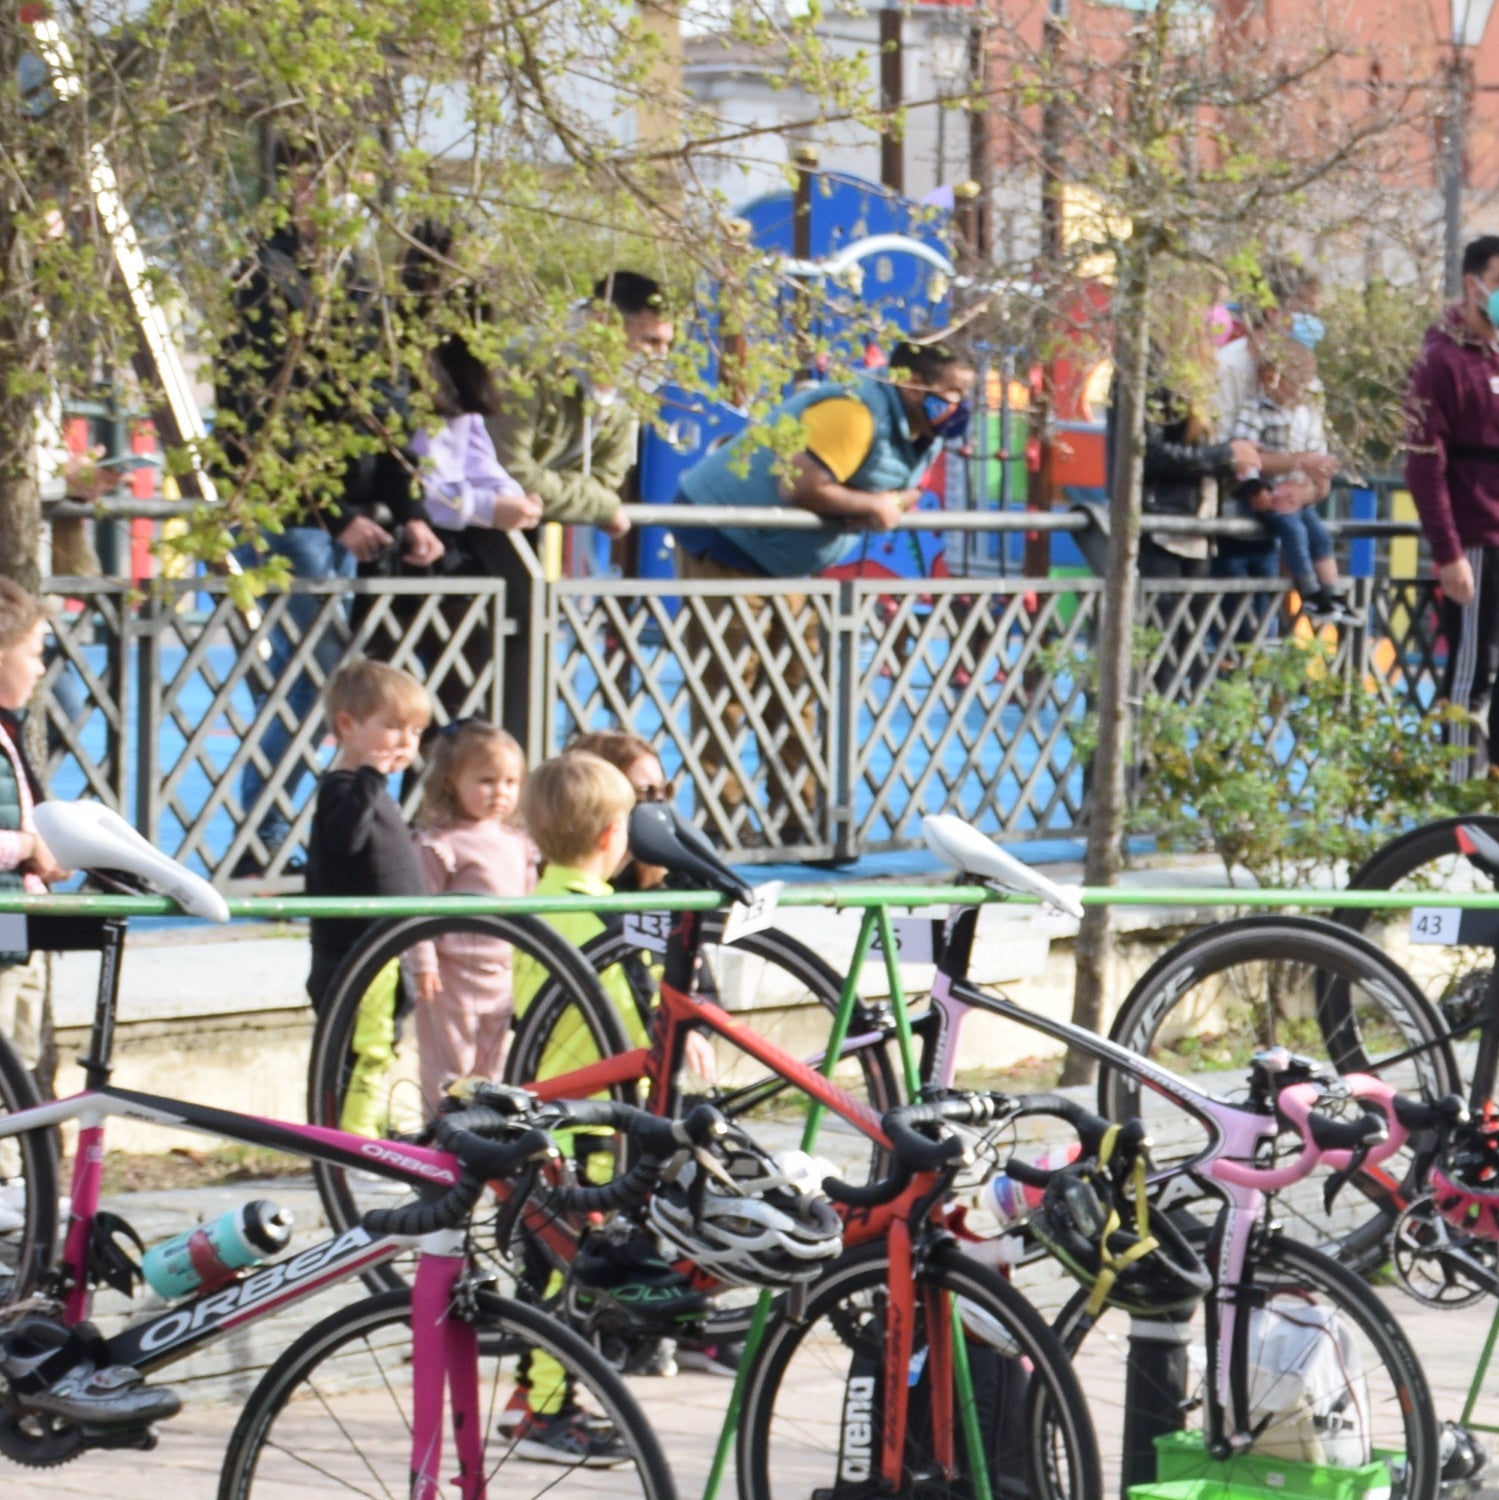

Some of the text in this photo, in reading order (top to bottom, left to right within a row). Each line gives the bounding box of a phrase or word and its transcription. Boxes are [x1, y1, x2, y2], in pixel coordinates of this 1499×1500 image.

[1415, 913, 1443, 936] 43
[361, 1143, 456, 1183] ORBEA
[139, 1226, 374, 1352] ORBEA
[840, 1376, 876, 1482] arena
